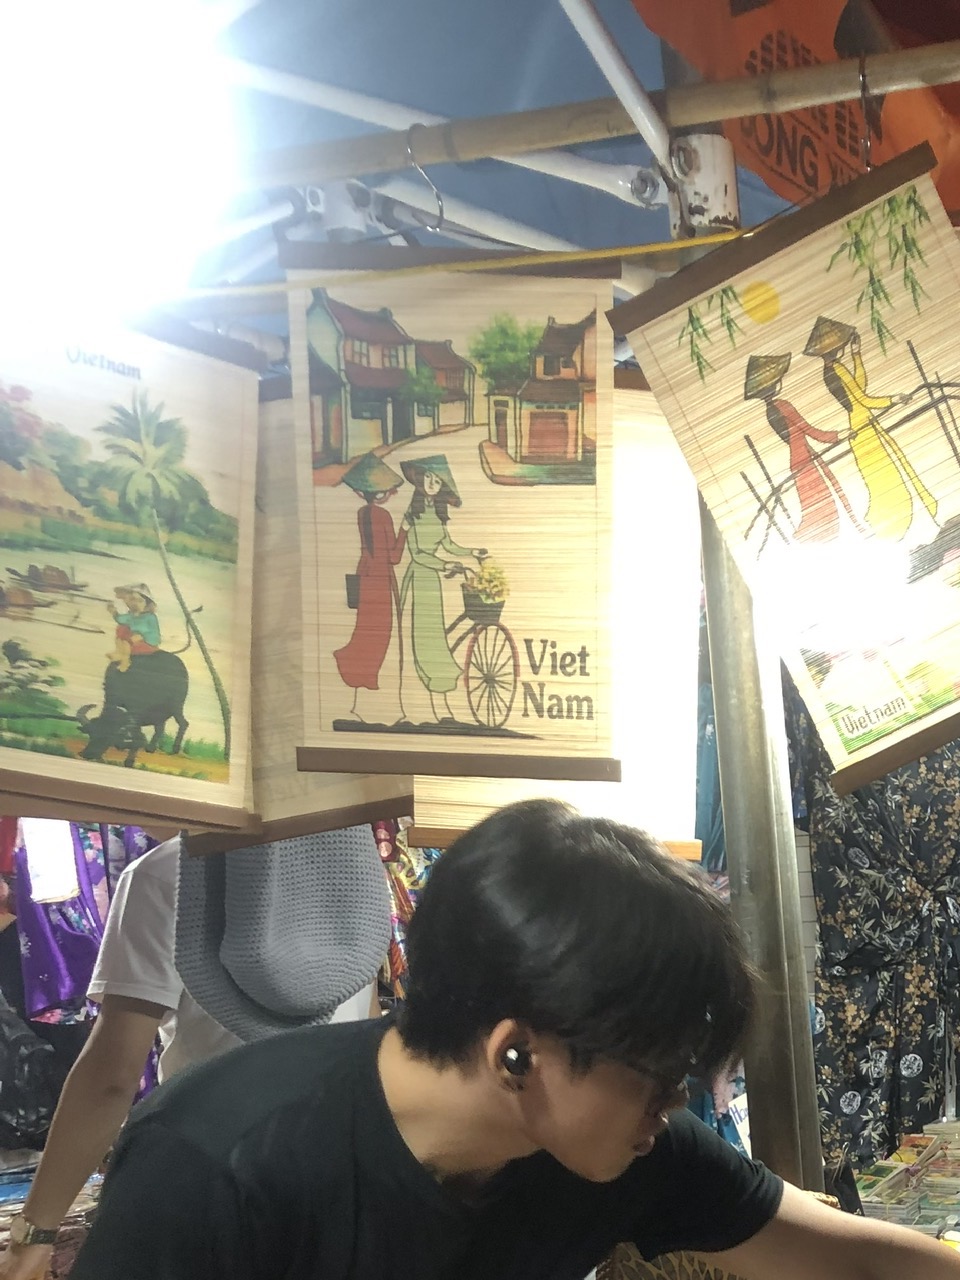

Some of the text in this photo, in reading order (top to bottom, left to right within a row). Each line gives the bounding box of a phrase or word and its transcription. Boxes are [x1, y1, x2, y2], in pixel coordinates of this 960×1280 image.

[523, 638, 590, 677] Viet
[521, 681, 595, 721] Nam
[841, 696, 907, 735] Vietnam
